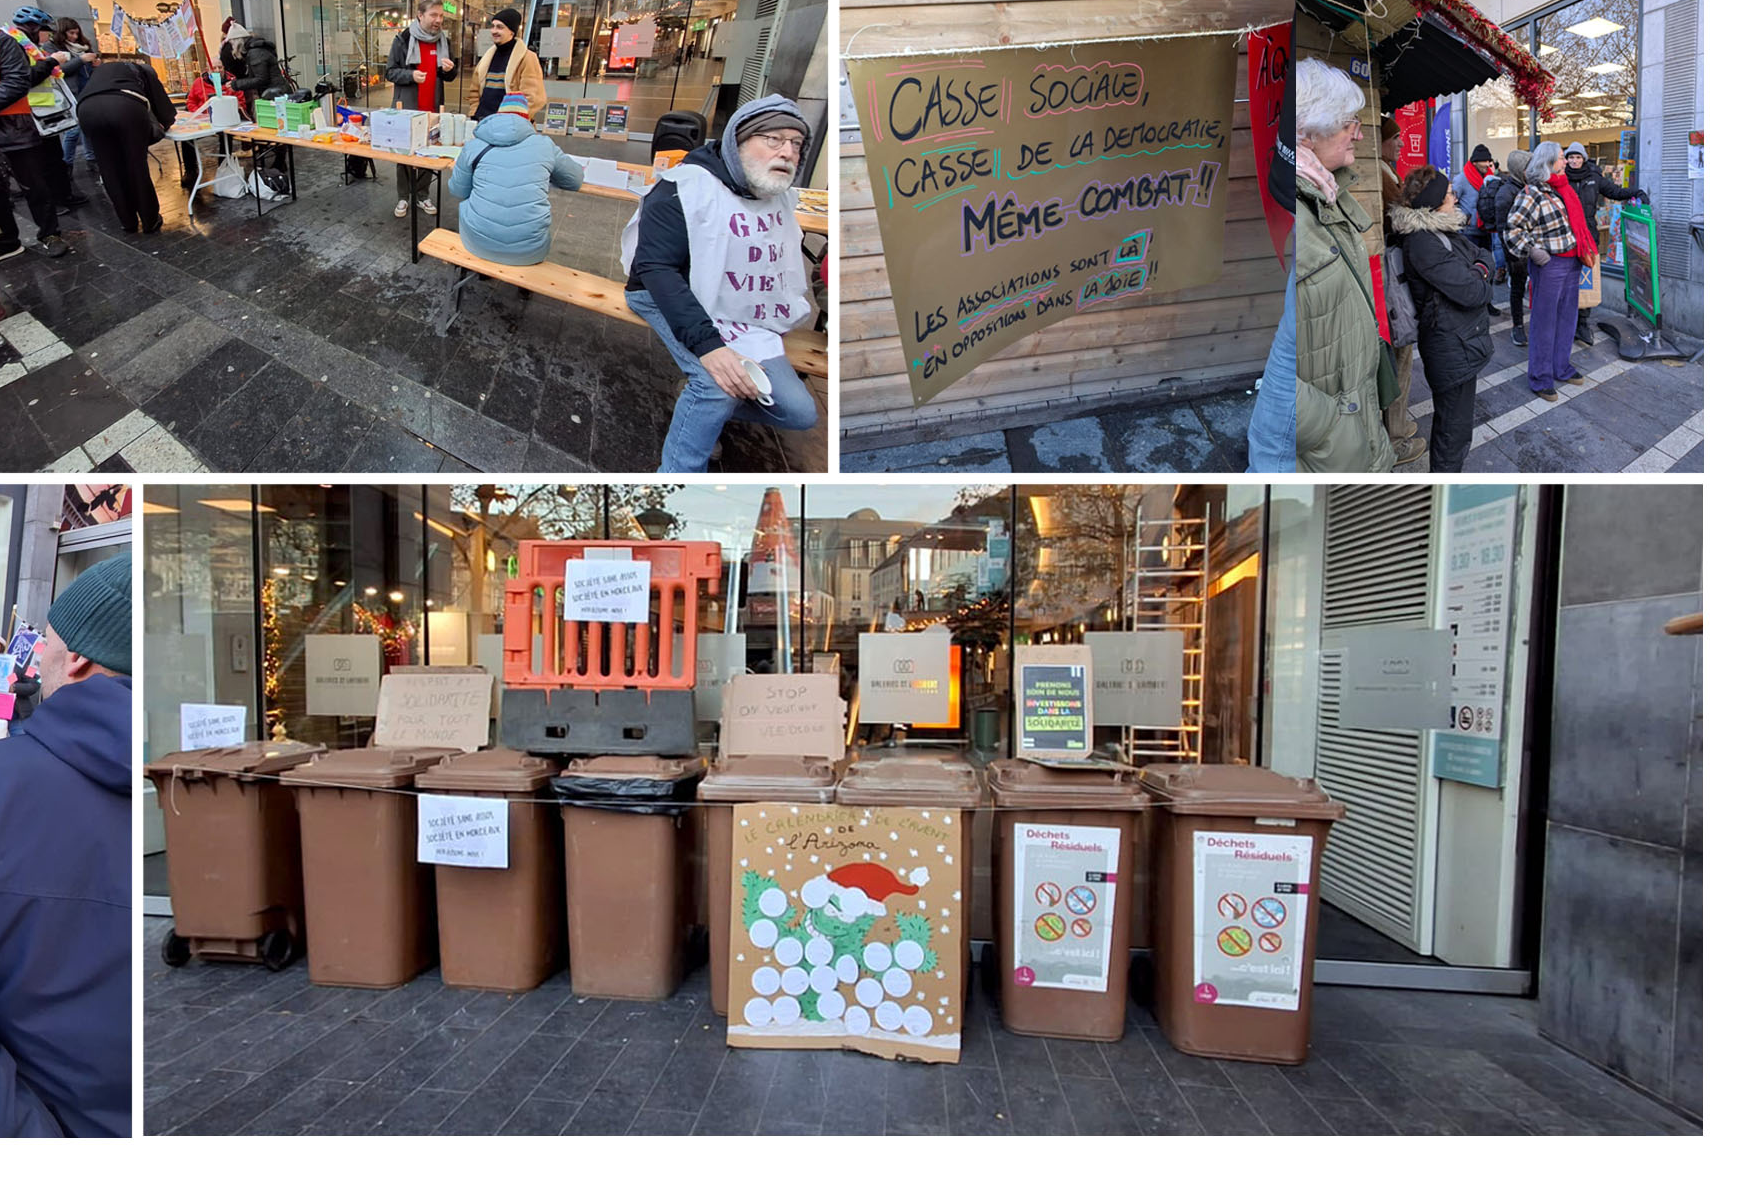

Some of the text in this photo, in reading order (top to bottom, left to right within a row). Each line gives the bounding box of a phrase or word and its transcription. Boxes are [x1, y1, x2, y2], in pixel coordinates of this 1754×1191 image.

[1351, 59, 1370, 78] 60
[889, 70, 1150, 141] CASSE SOCIALE,
[894, 147, 994, 197] CASSE
[1016, 141, 1054, 171] DE
[1069, 131, 1095, 158] LA
[962, 164, 1215, 253] MÊME COMBAT !!
[914, 239, 1140, 344] LES ASSOCIATIONS SONT LÀ
[753, 303, 791, 320] EN
[923, 351, 948, 379] EN
[952, 309, 1028, 360] OPPOSITION
[1036, 290, 1074, 316] DANS
[1083, 283, 1099, 300] LA
[1103, 269, 1143, 296] JOIE
[600, 589, 609, 600] EN
[1034, 681, 1072, 690] PRENONS
[766, 686, 807, 700] STOP
[1026, 688, 1080, 697] SOIN DE NOUS
[1026, 699, 1082, 708] INVESTISSONS
[1037, 707, 1071, 715] DANS LA
[414, 729, 461, 742] MONDE
[457, 814, 474, 826] SANS
[455, 830, 465, 841] EN
[466, 825, 502, 839] MORCEAUX
[745, 810, 950, 844] LE CALENDRIER DE L'AVENT
[838, 825, 856, 834] DE
[1025, 828, 1070, 841] Déchets
[785, 832, 881, 857] l'Arizona
[1050, 840, 1104, 853] Résiduels
[1206, 837, 1256, 849] Déchets
[1234, 849, 1292, 862] Résiduels
